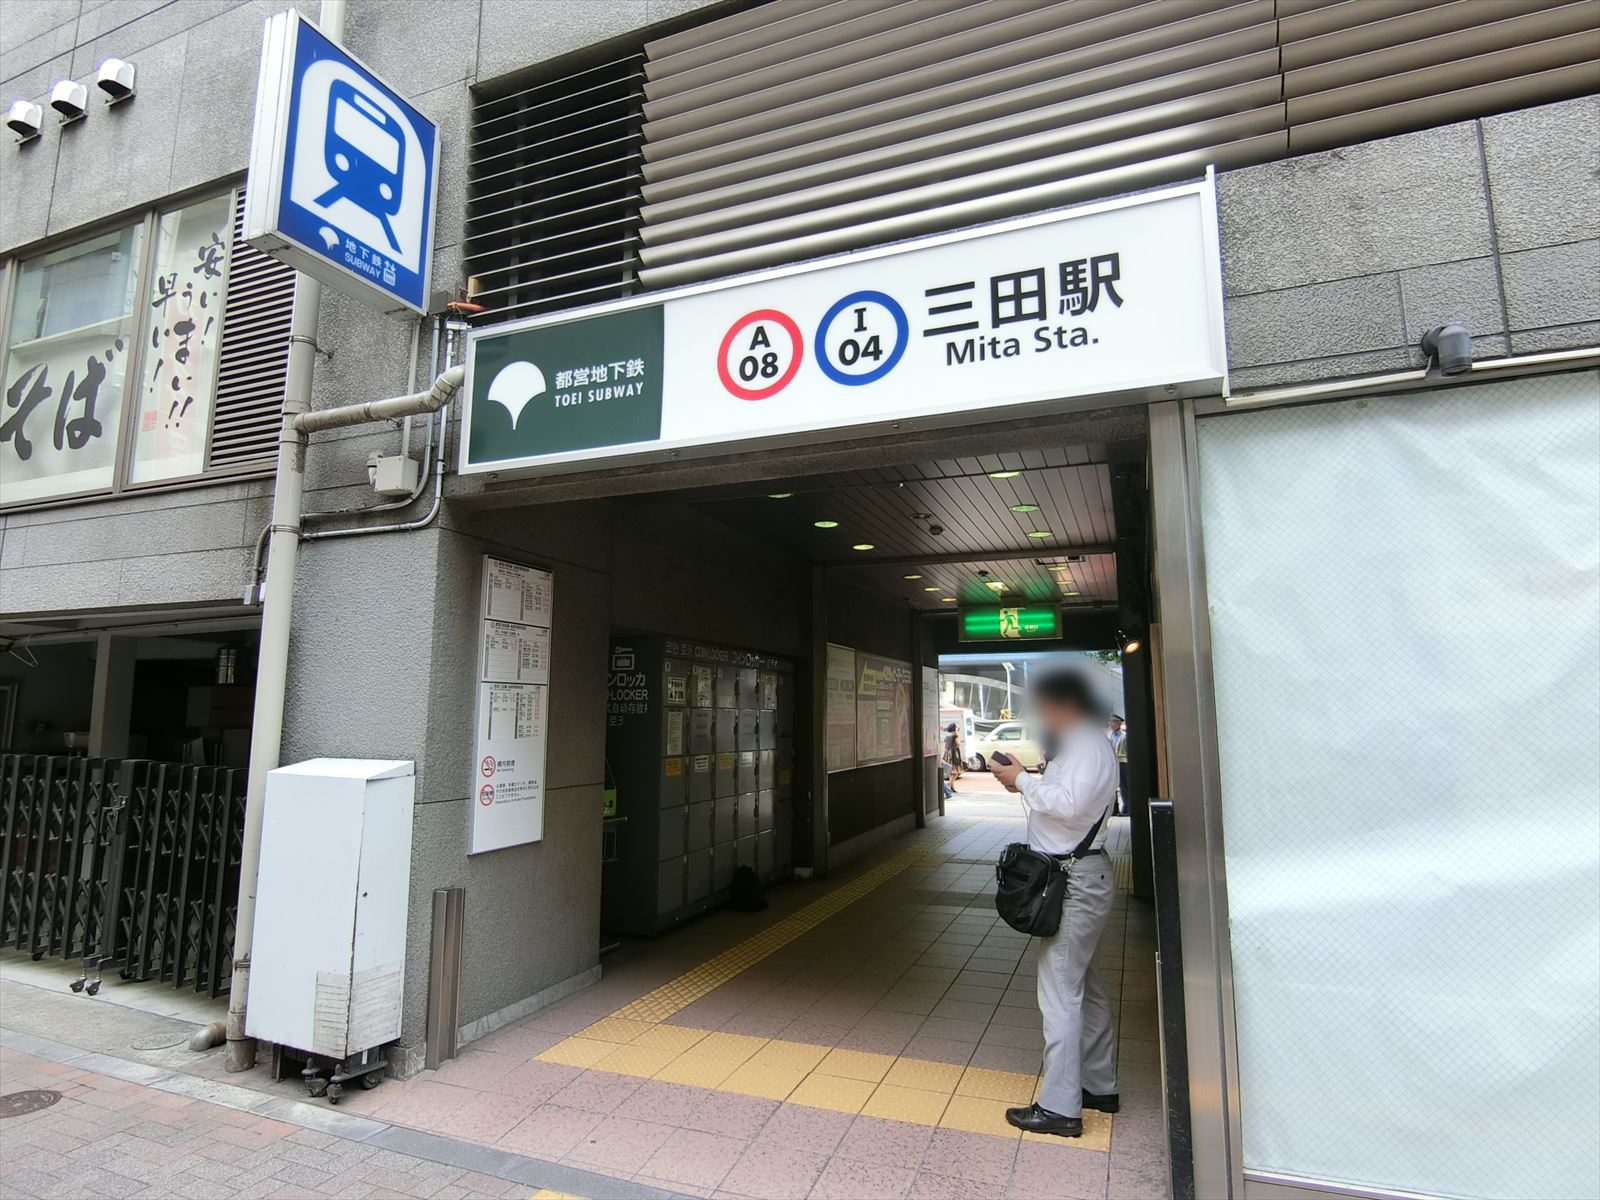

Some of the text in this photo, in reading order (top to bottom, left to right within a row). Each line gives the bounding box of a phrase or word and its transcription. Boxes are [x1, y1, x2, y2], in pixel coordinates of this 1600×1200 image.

[345, 239, 382, 268] 地下鉄
[345, 252, 381, 279] SUBWAY
[922, 252, 1124, 338] 三田駅
[853, 307, 868, 333] I
[748, 326, 771, 351] A
[838, 335, 883, 367] 04
[945, 325, 1100, 367] Mita Sta.
[555, 358, 645, 390] 都営地下鉄
[738, 352, 779, 382] 08
[0, 337, 124, 461] そば
[555, 382, 644, 408] TOEI SUBWAY
